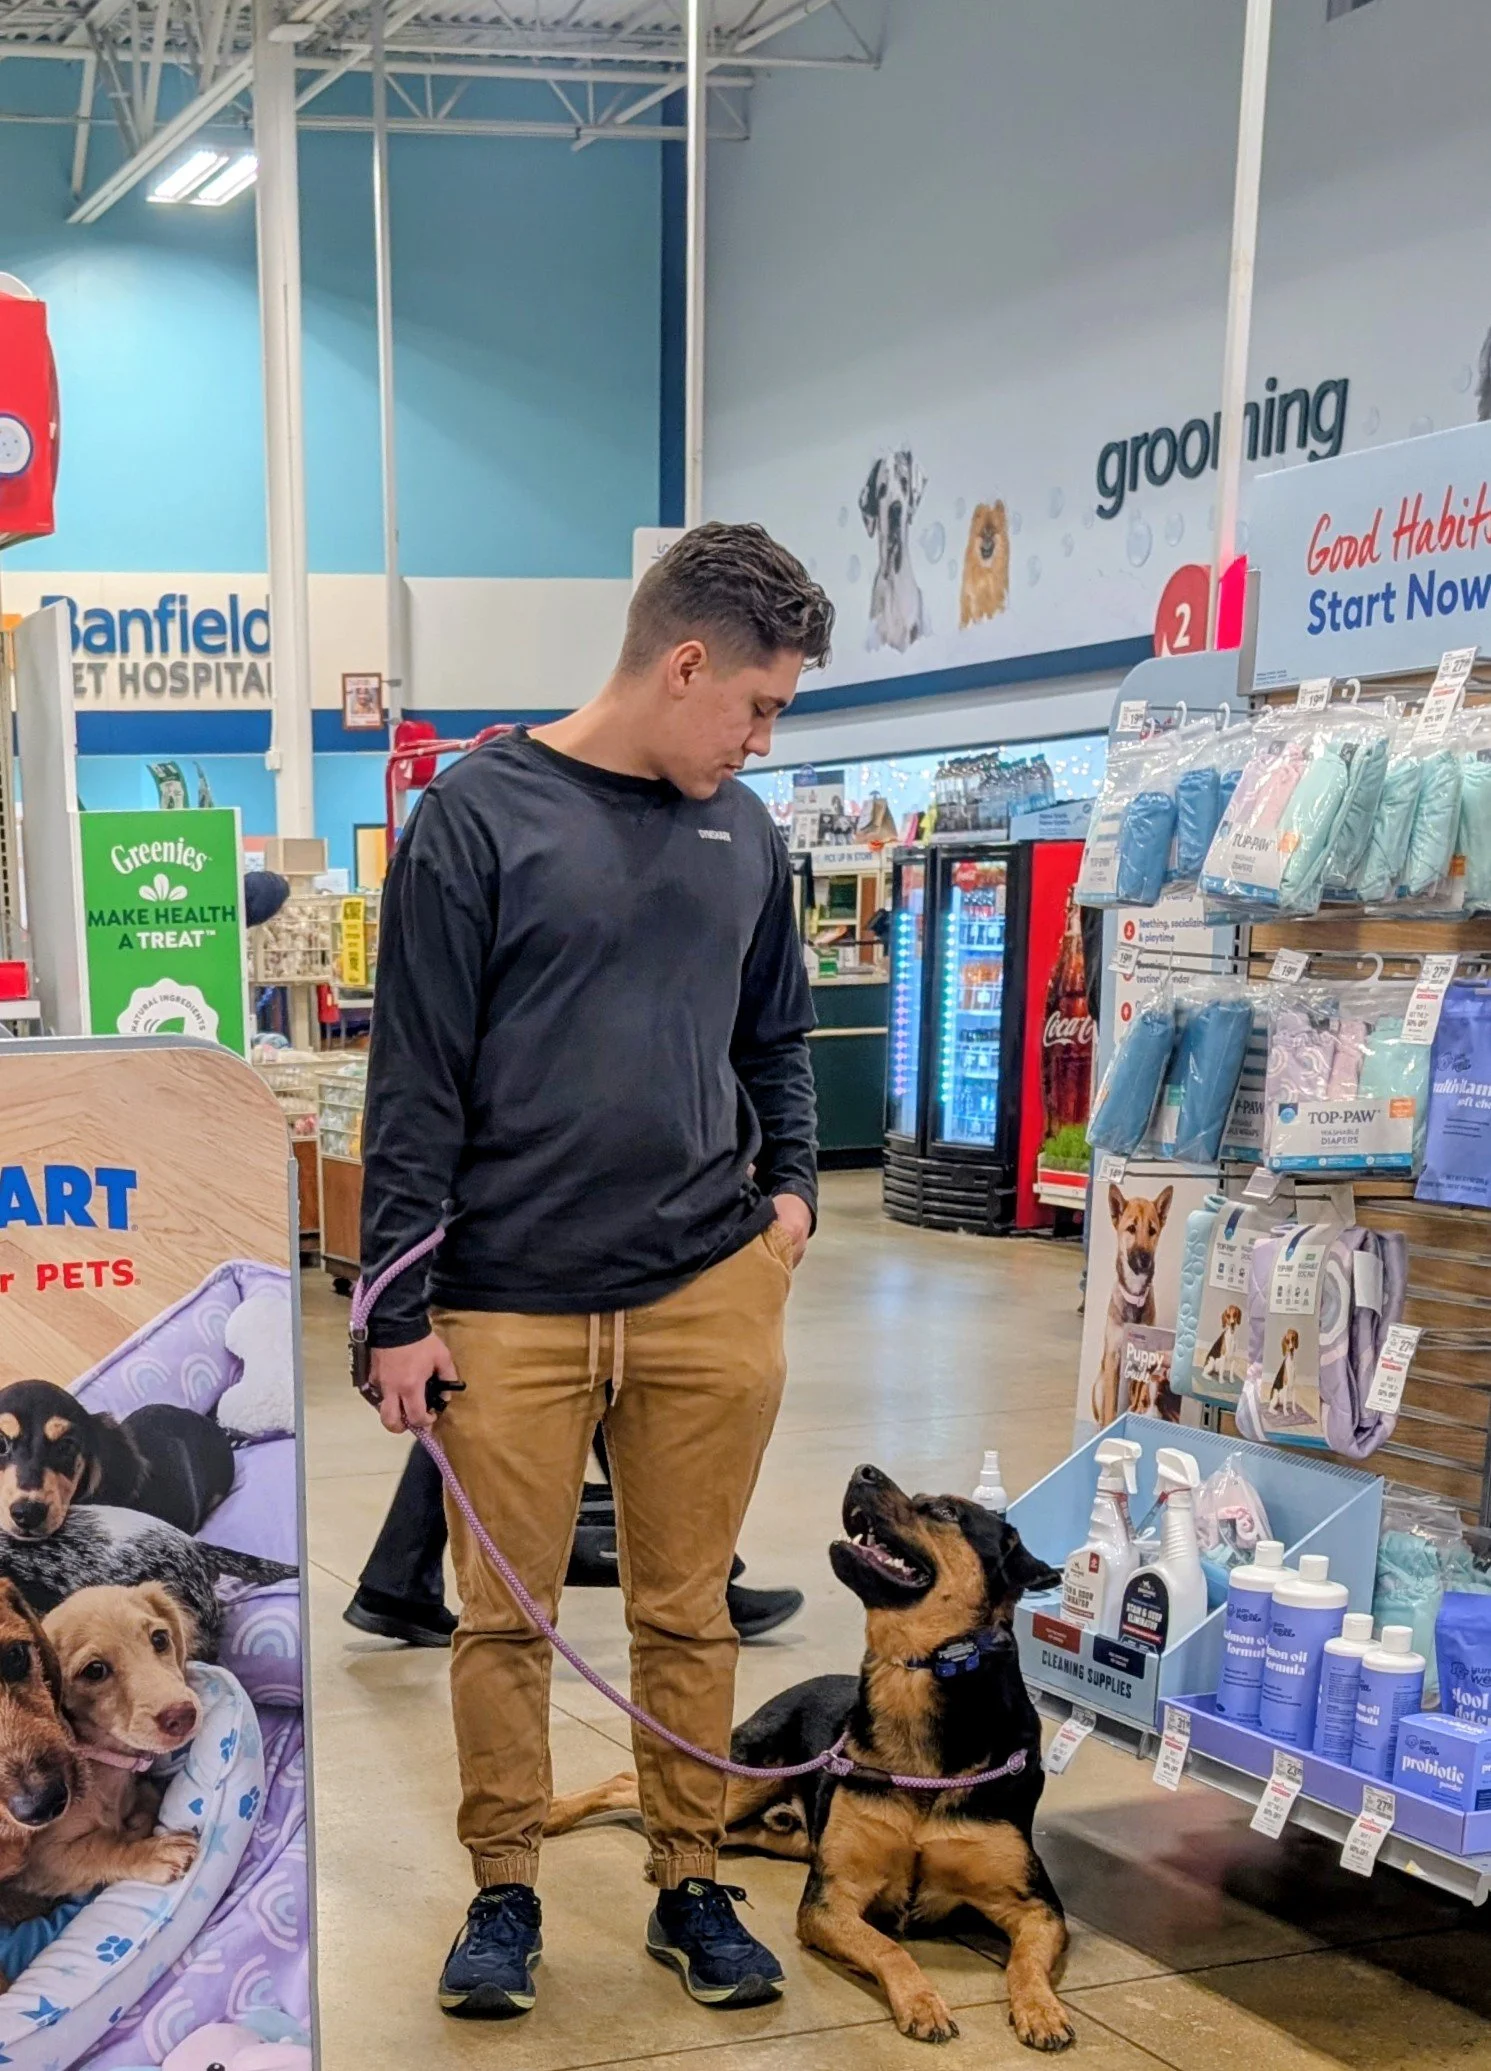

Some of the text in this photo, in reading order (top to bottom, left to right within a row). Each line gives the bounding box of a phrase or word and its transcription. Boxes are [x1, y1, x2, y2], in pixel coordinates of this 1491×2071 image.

[1307, 507, 1383, 575] Good
[1307, 582, 1396, 635] Start
[1173, 602, 1191, 648] 2
[71, 660, 272, 697] ET HOSPITA
[111, 836, 208, 875] Greenies
[88, 905, 236, 928] MAKE HEALTH
[118, 932, 134, 950] A
[159, 995, 206, 1031] INGREDIENTS
[1321, 1136, 1359, 1145] DIAPERS
[36, 1259, 135, 1291] PETS
[1126, 1342, 1164, 1371] Puppy
[1226, 1642, 1266, 1658] formul
[1290, 1651, 1308, 1664] oil
[1041, 1649, 1084, 1680] CLEANING
[1087, 1668, 1132, 1699] SUPPLIES
[1402, 1755, 1465, 1785] probiotic
